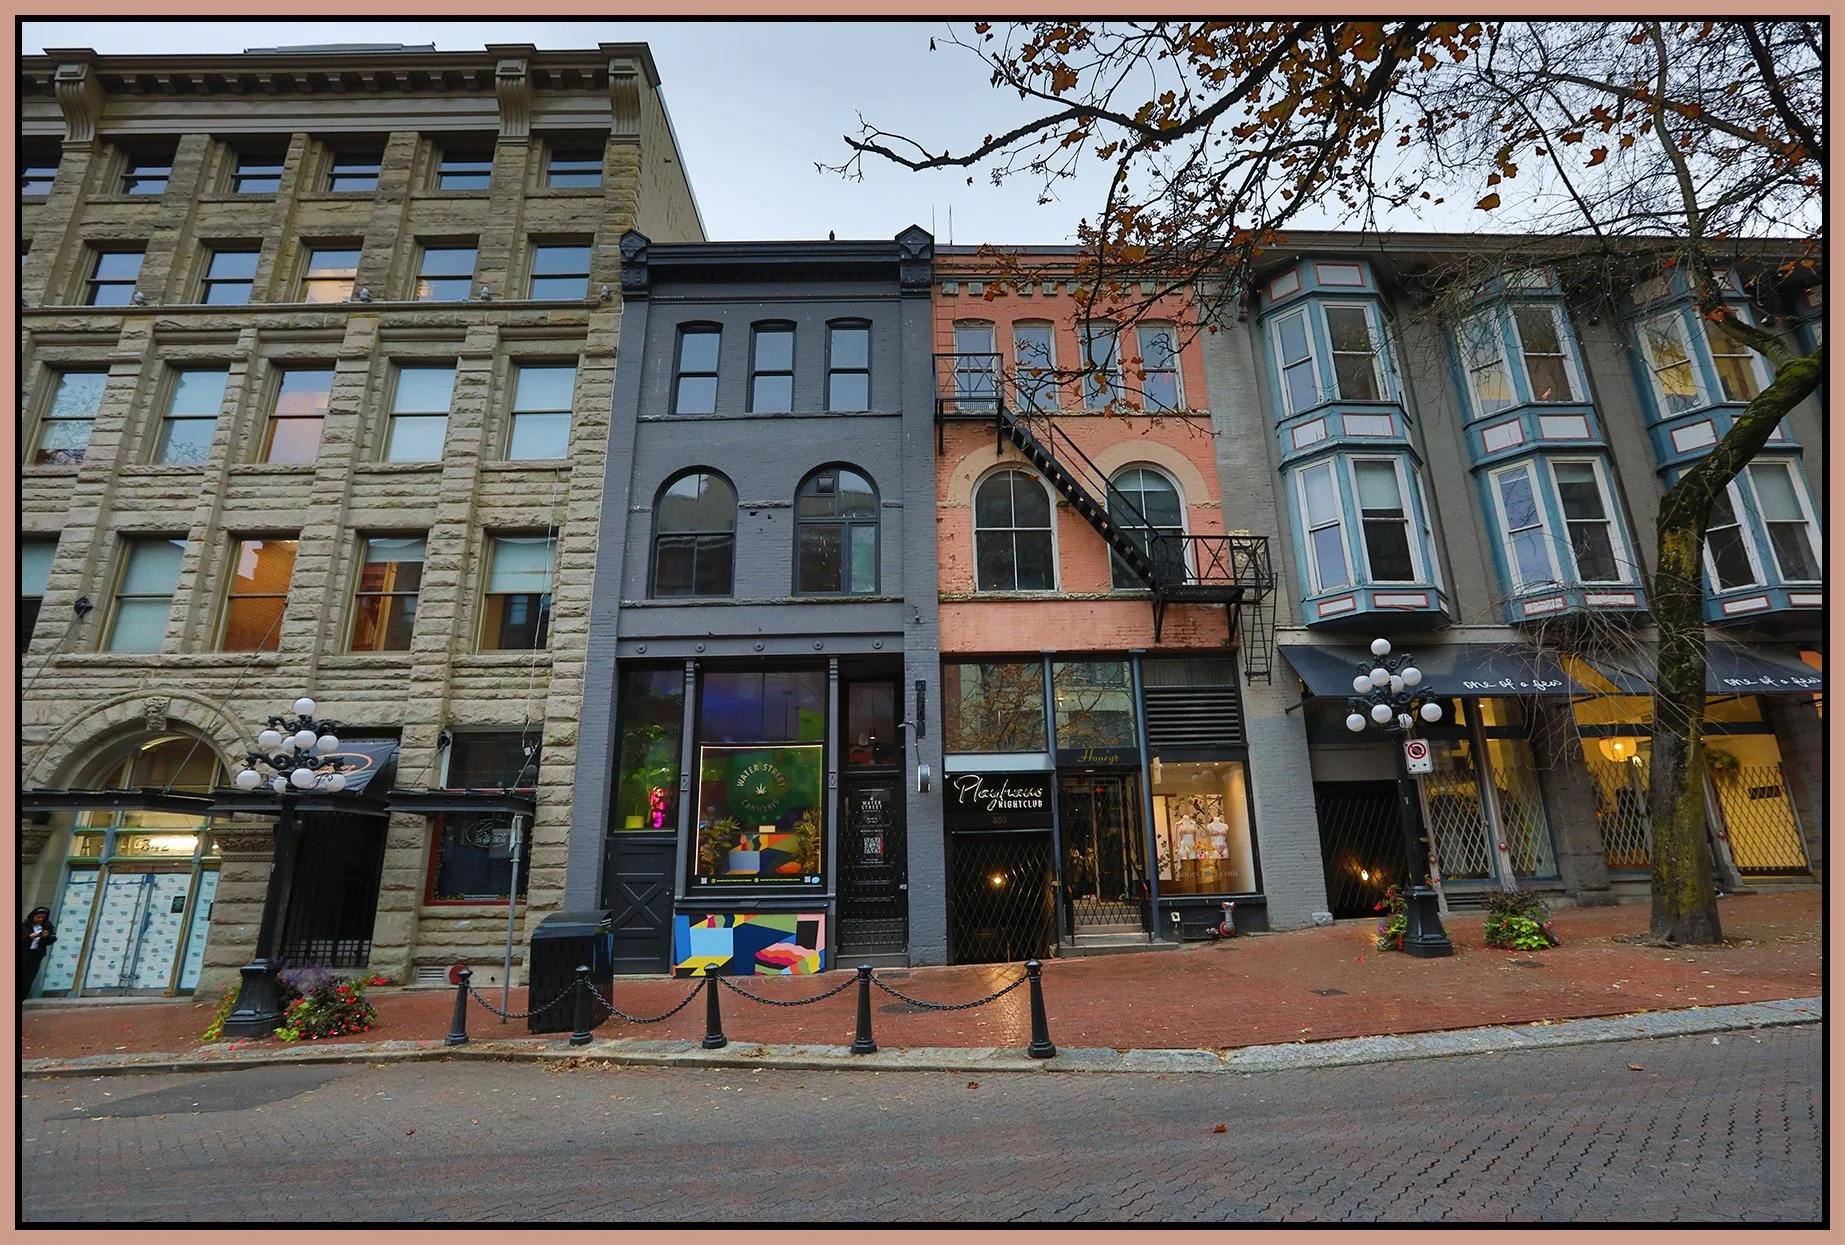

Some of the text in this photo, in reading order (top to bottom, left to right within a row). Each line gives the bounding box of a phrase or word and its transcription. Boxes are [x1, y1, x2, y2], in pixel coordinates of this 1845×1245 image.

[1463, 680, 1497, 689] one
[1499, 678, 1516, 690] of
[1724, 678, 1759, 686] one
[1759, 675, 1780, 687] of
[736, 763, 786, 787] WATER STREET
[741, 799, 780, 812] CANNABIS
[998, 800, 1043, 809] NIGHTCLUB
[992, 816, 1007, 825] 350
[141, 839, 169, 851] 342
